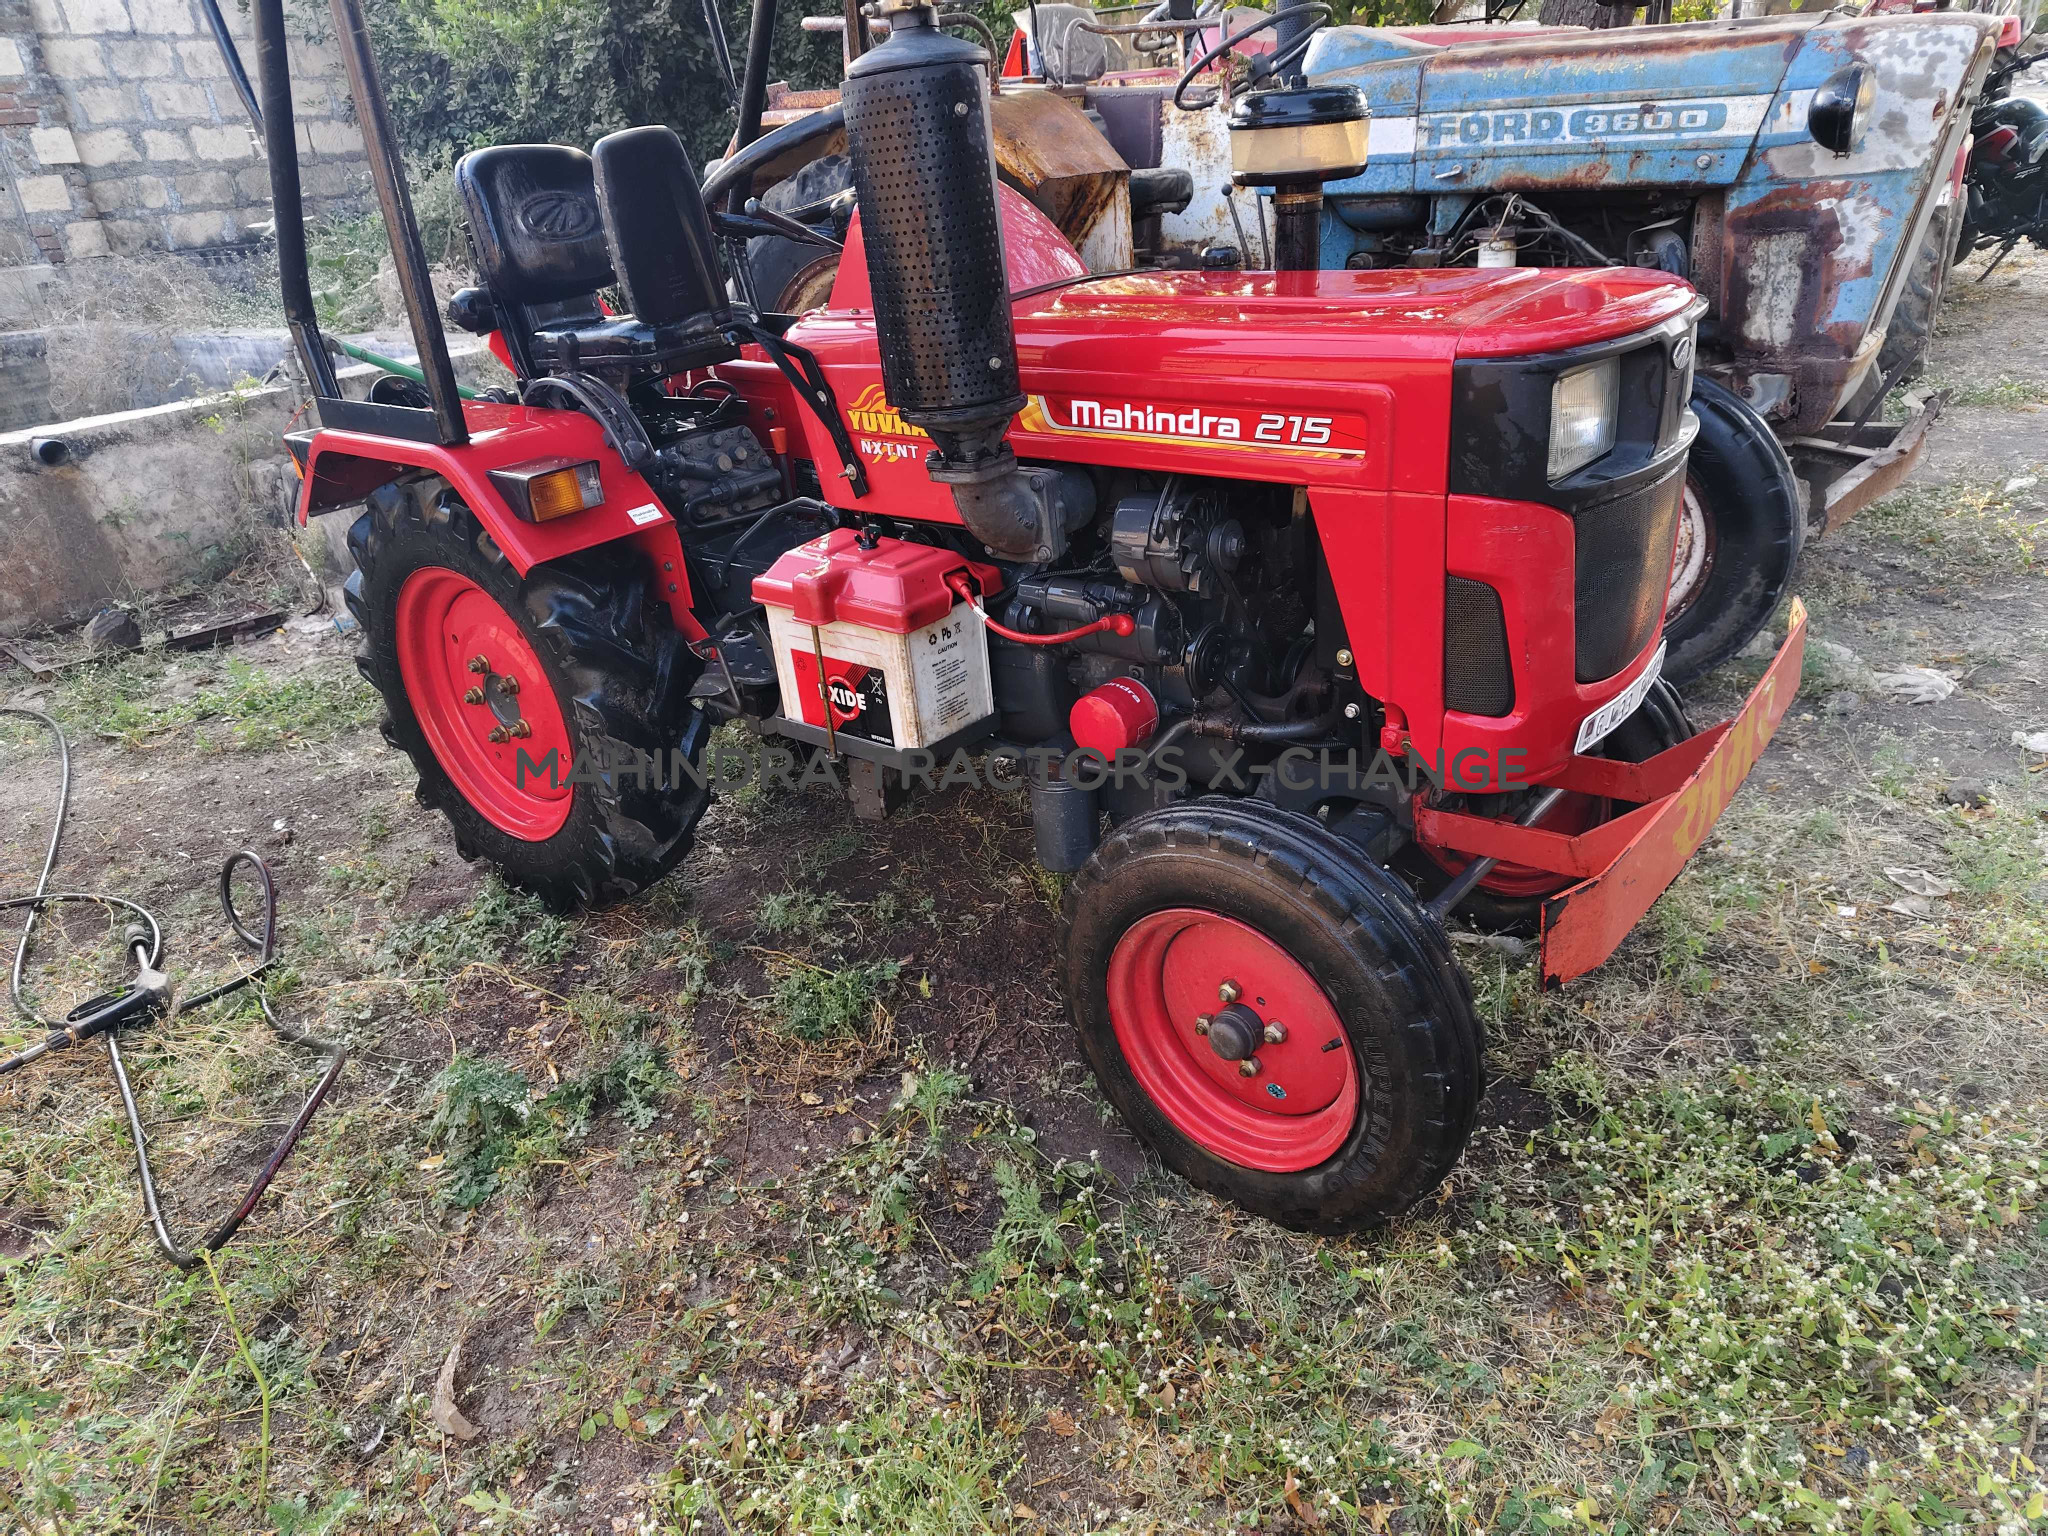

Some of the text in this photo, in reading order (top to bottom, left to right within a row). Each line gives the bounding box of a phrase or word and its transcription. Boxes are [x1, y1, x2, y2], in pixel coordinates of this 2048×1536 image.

[1424, 108, 1709, 147] FORD 3600
[1071, 399, 1333, 445] Mahindra 215
[941, 627, 952, 641] Pb
[937, 641, 958, 655] CAUTION
